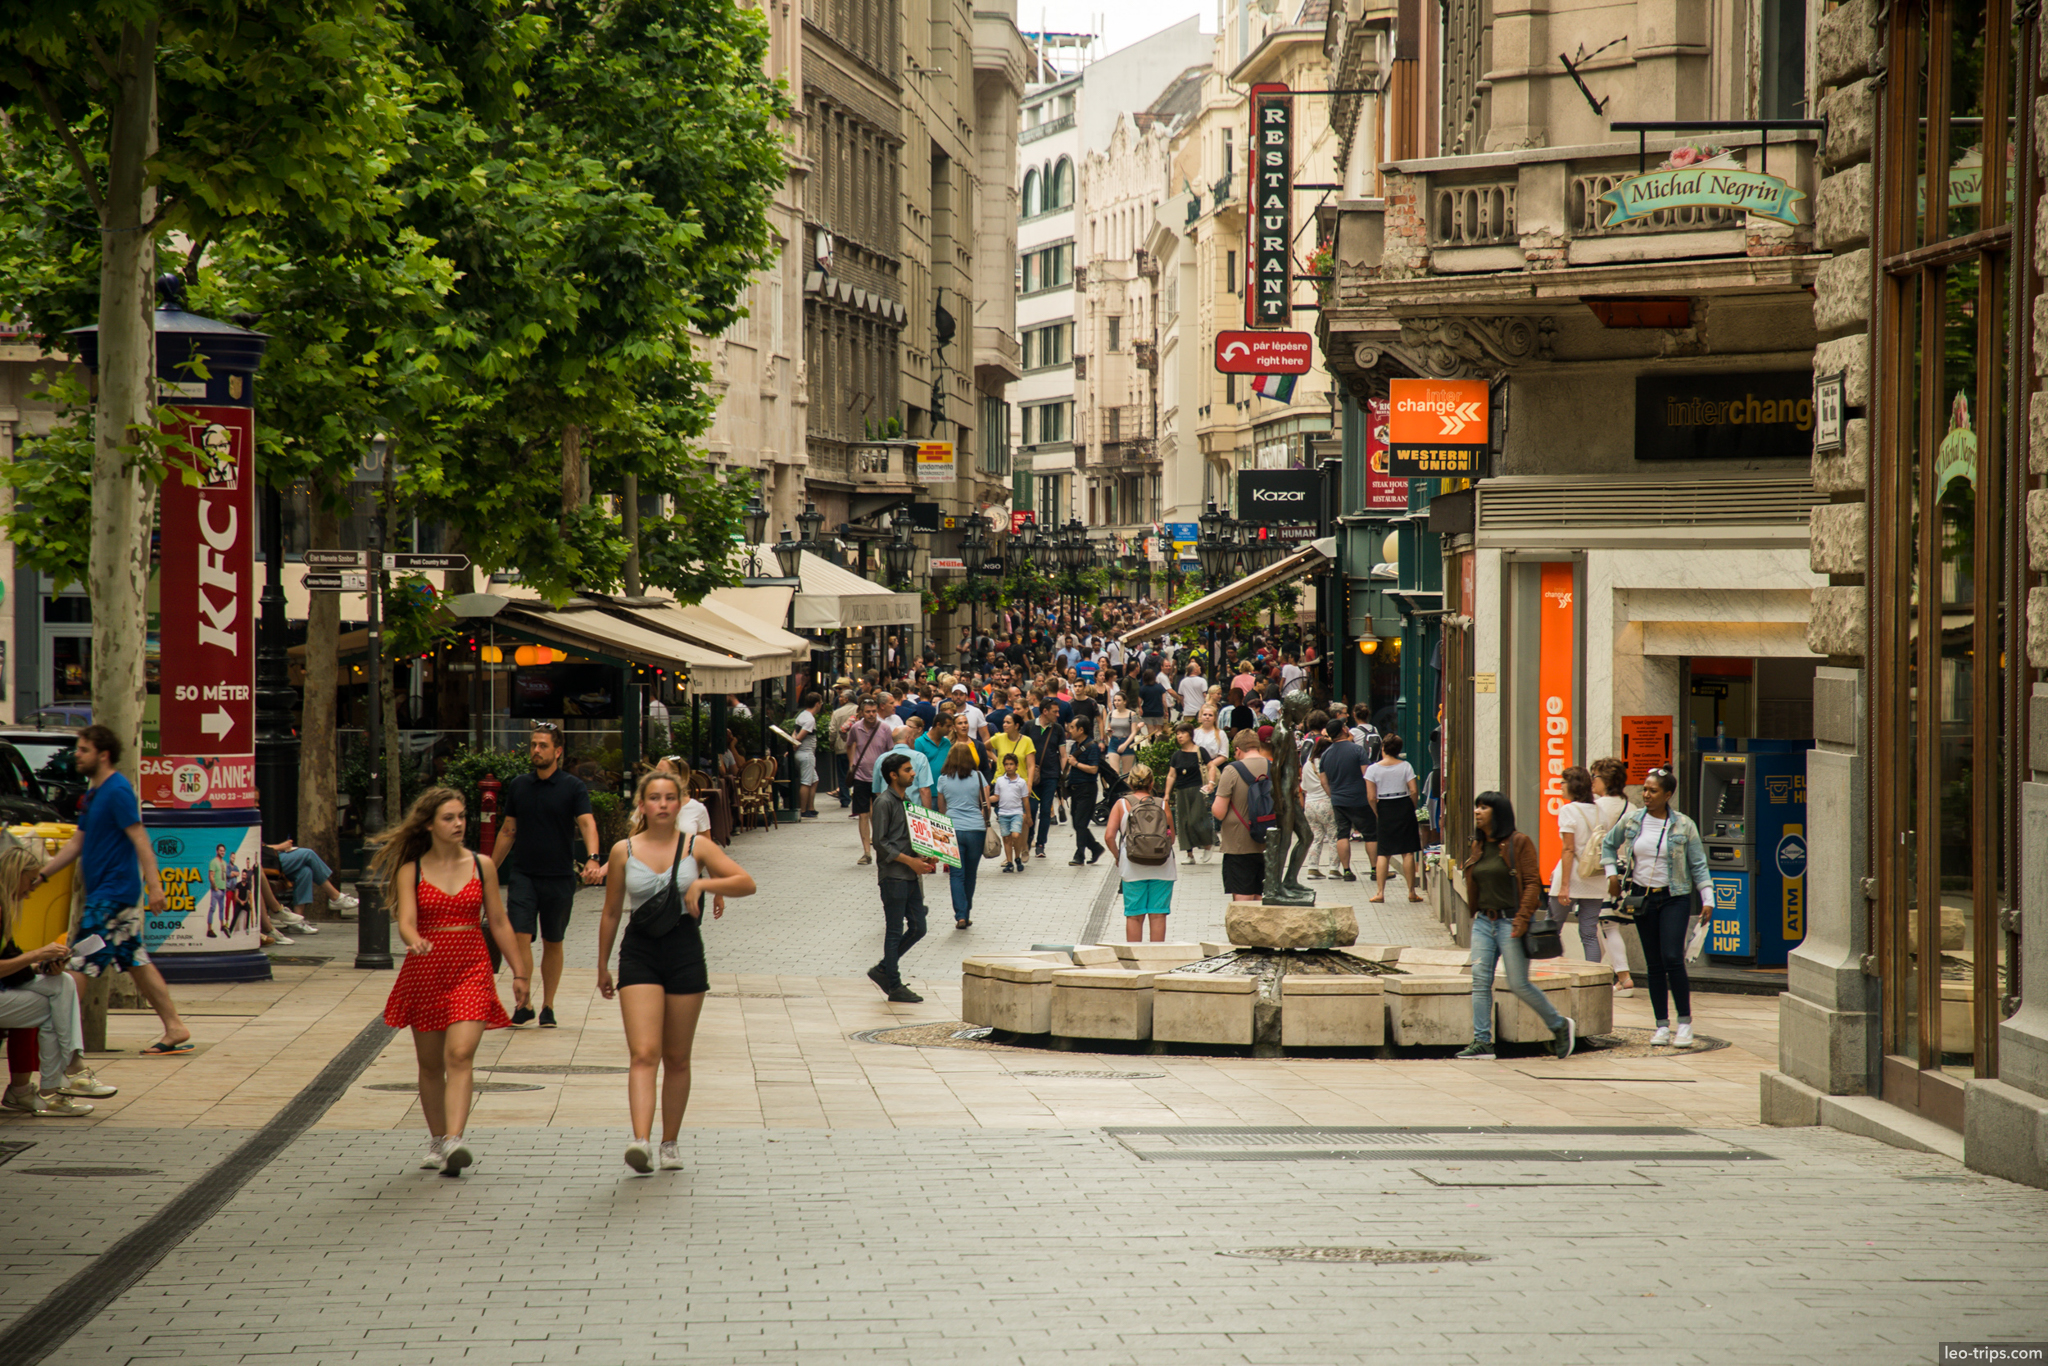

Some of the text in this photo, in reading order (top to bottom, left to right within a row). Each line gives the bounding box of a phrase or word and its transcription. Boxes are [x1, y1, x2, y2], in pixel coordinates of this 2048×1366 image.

[1631, 171, 1778, 205] Michal Negrin
[1262, 108, 1286, 315] RESTAURANT
[1253, 341, 1308, 352] pár lépésre
[1256, 355, 1304, 367] right here
[1426, 388, 1463, 402] inter
[1397, 398, 1456, 416] change
[1667, 393, 1815, 431] interchang
[1396, 449, 1468, 460] WESTERN
[917, 463, 954, 471] undamenta
[1418, 460, 1468, 471] UNION
[1372, 480, 1408, 488] STEAK HOUS
[1252, 488, 1306, 501] Kazar
[1372, 495, 1408, 503] RESTAURAN
[1281, 528, 1316, 538] HUMAN
[422, 558, 439, 567] Country
[1181, 562, 1201, 572] CHAN
[198, 499, 238, 657] KFC
[1544, 590, 1564, 599] change
[174, 680, 250, 701] 50 MÉTER
[1543, 695, 1569, 817] change
[179, 773, 201, 783] STR
[1794, 775, 1807, 788] EU
[179, 783, 201, 793] AND
[208, 793, 226, 801] AUG
[227, 792, 237, 801] 23
[1794, 791, 1807, 804] HU
[929, 820, 954, 834] NAILS
[157, 846, 178, 856] PARK
[158, 867, 203, 882] GNA
[1787, 888, 1799, 932] ATM
[150, 920, 186, 930] 08.09.
[1713, 919, 1741, 936] EUR
[1713, 937, 1741, 952] HUF
